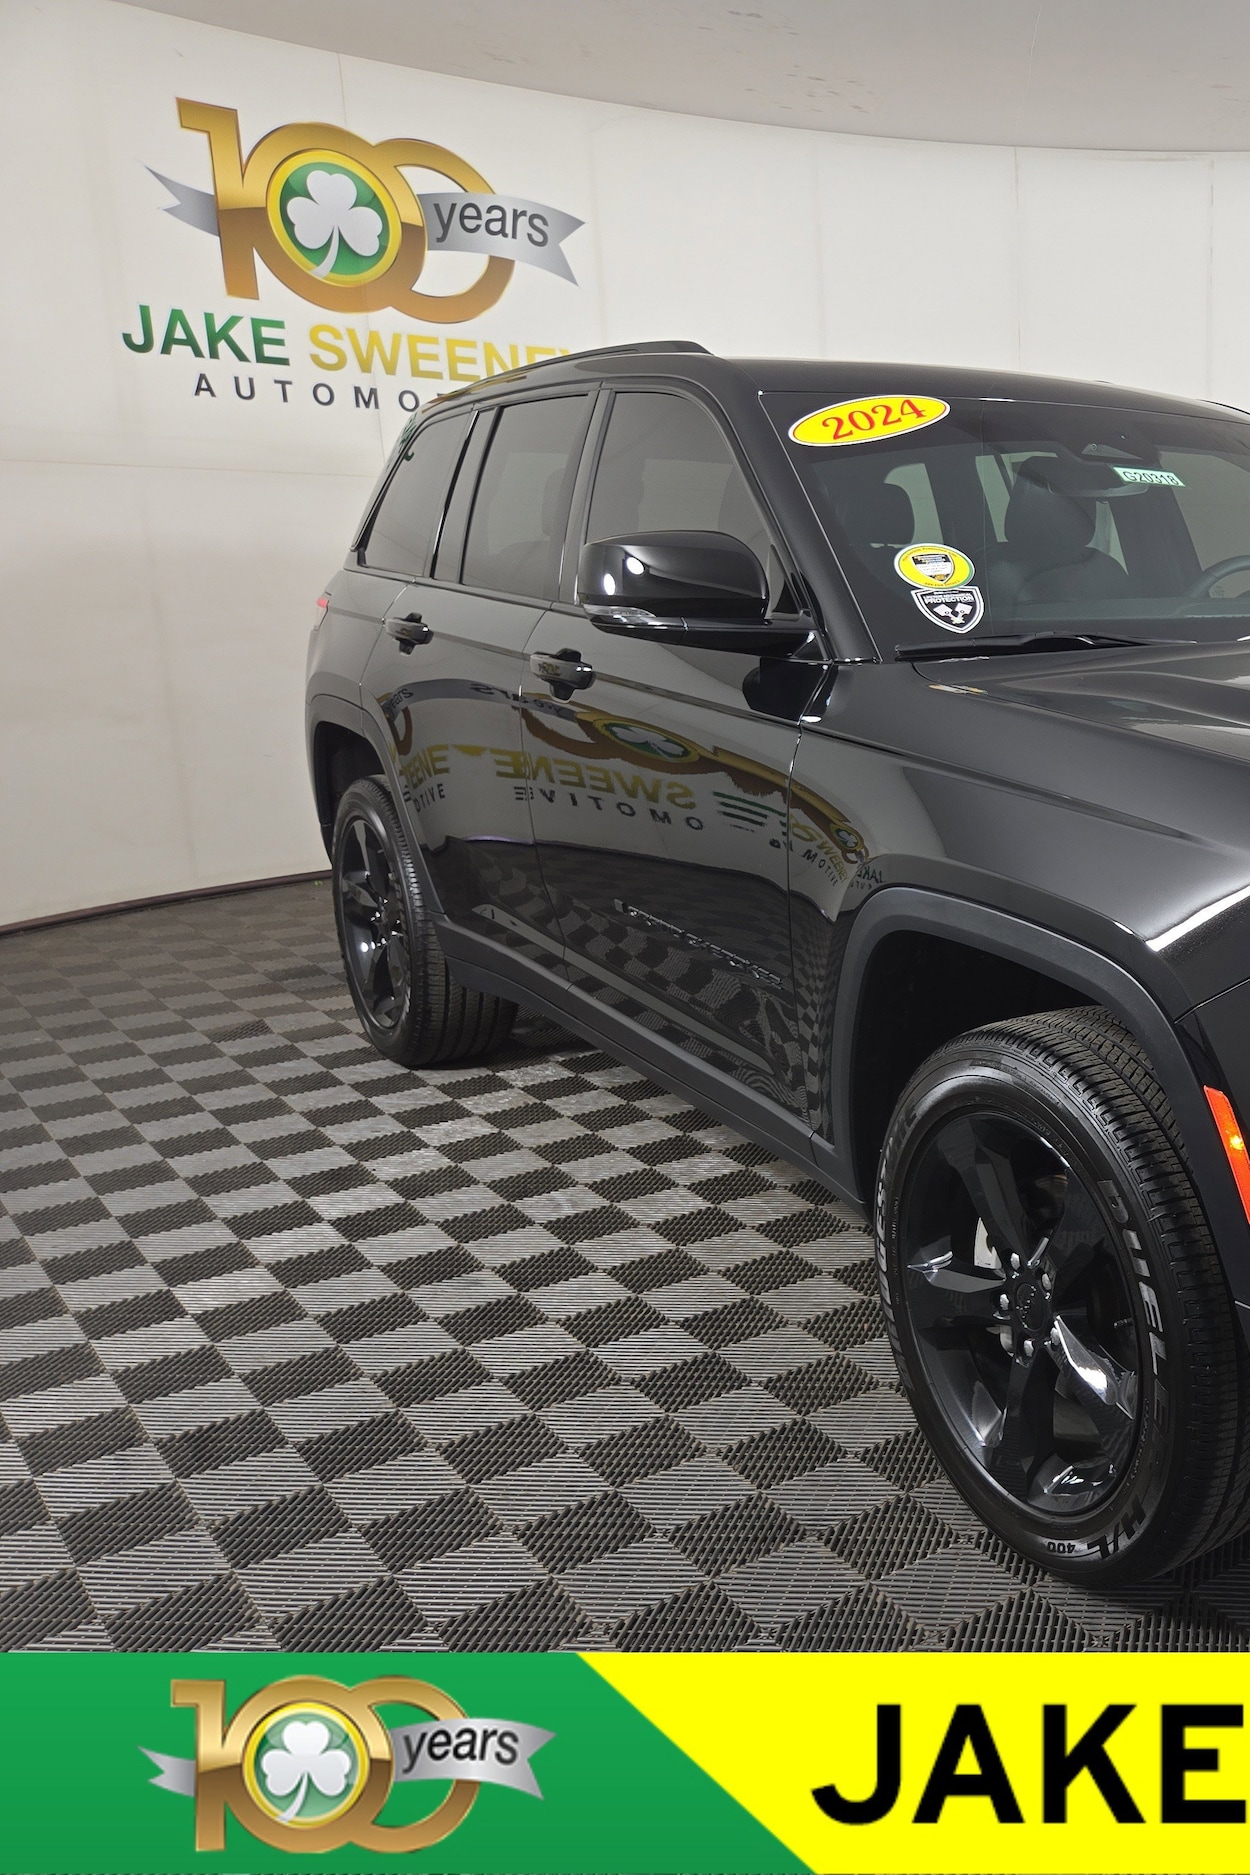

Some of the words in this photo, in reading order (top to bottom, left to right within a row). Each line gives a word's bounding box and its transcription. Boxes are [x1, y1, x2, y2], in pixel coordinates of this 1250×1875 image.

[434, 197, 549, 247] years
[122, 305, 290, 366] JAKE
[310, 325, 571, 383] SWEEN
[194, 373, 446, 412] AUTOMO
[823, 399, 927, 440] 2024
[1047, 1541, 1076, 1554] 400
